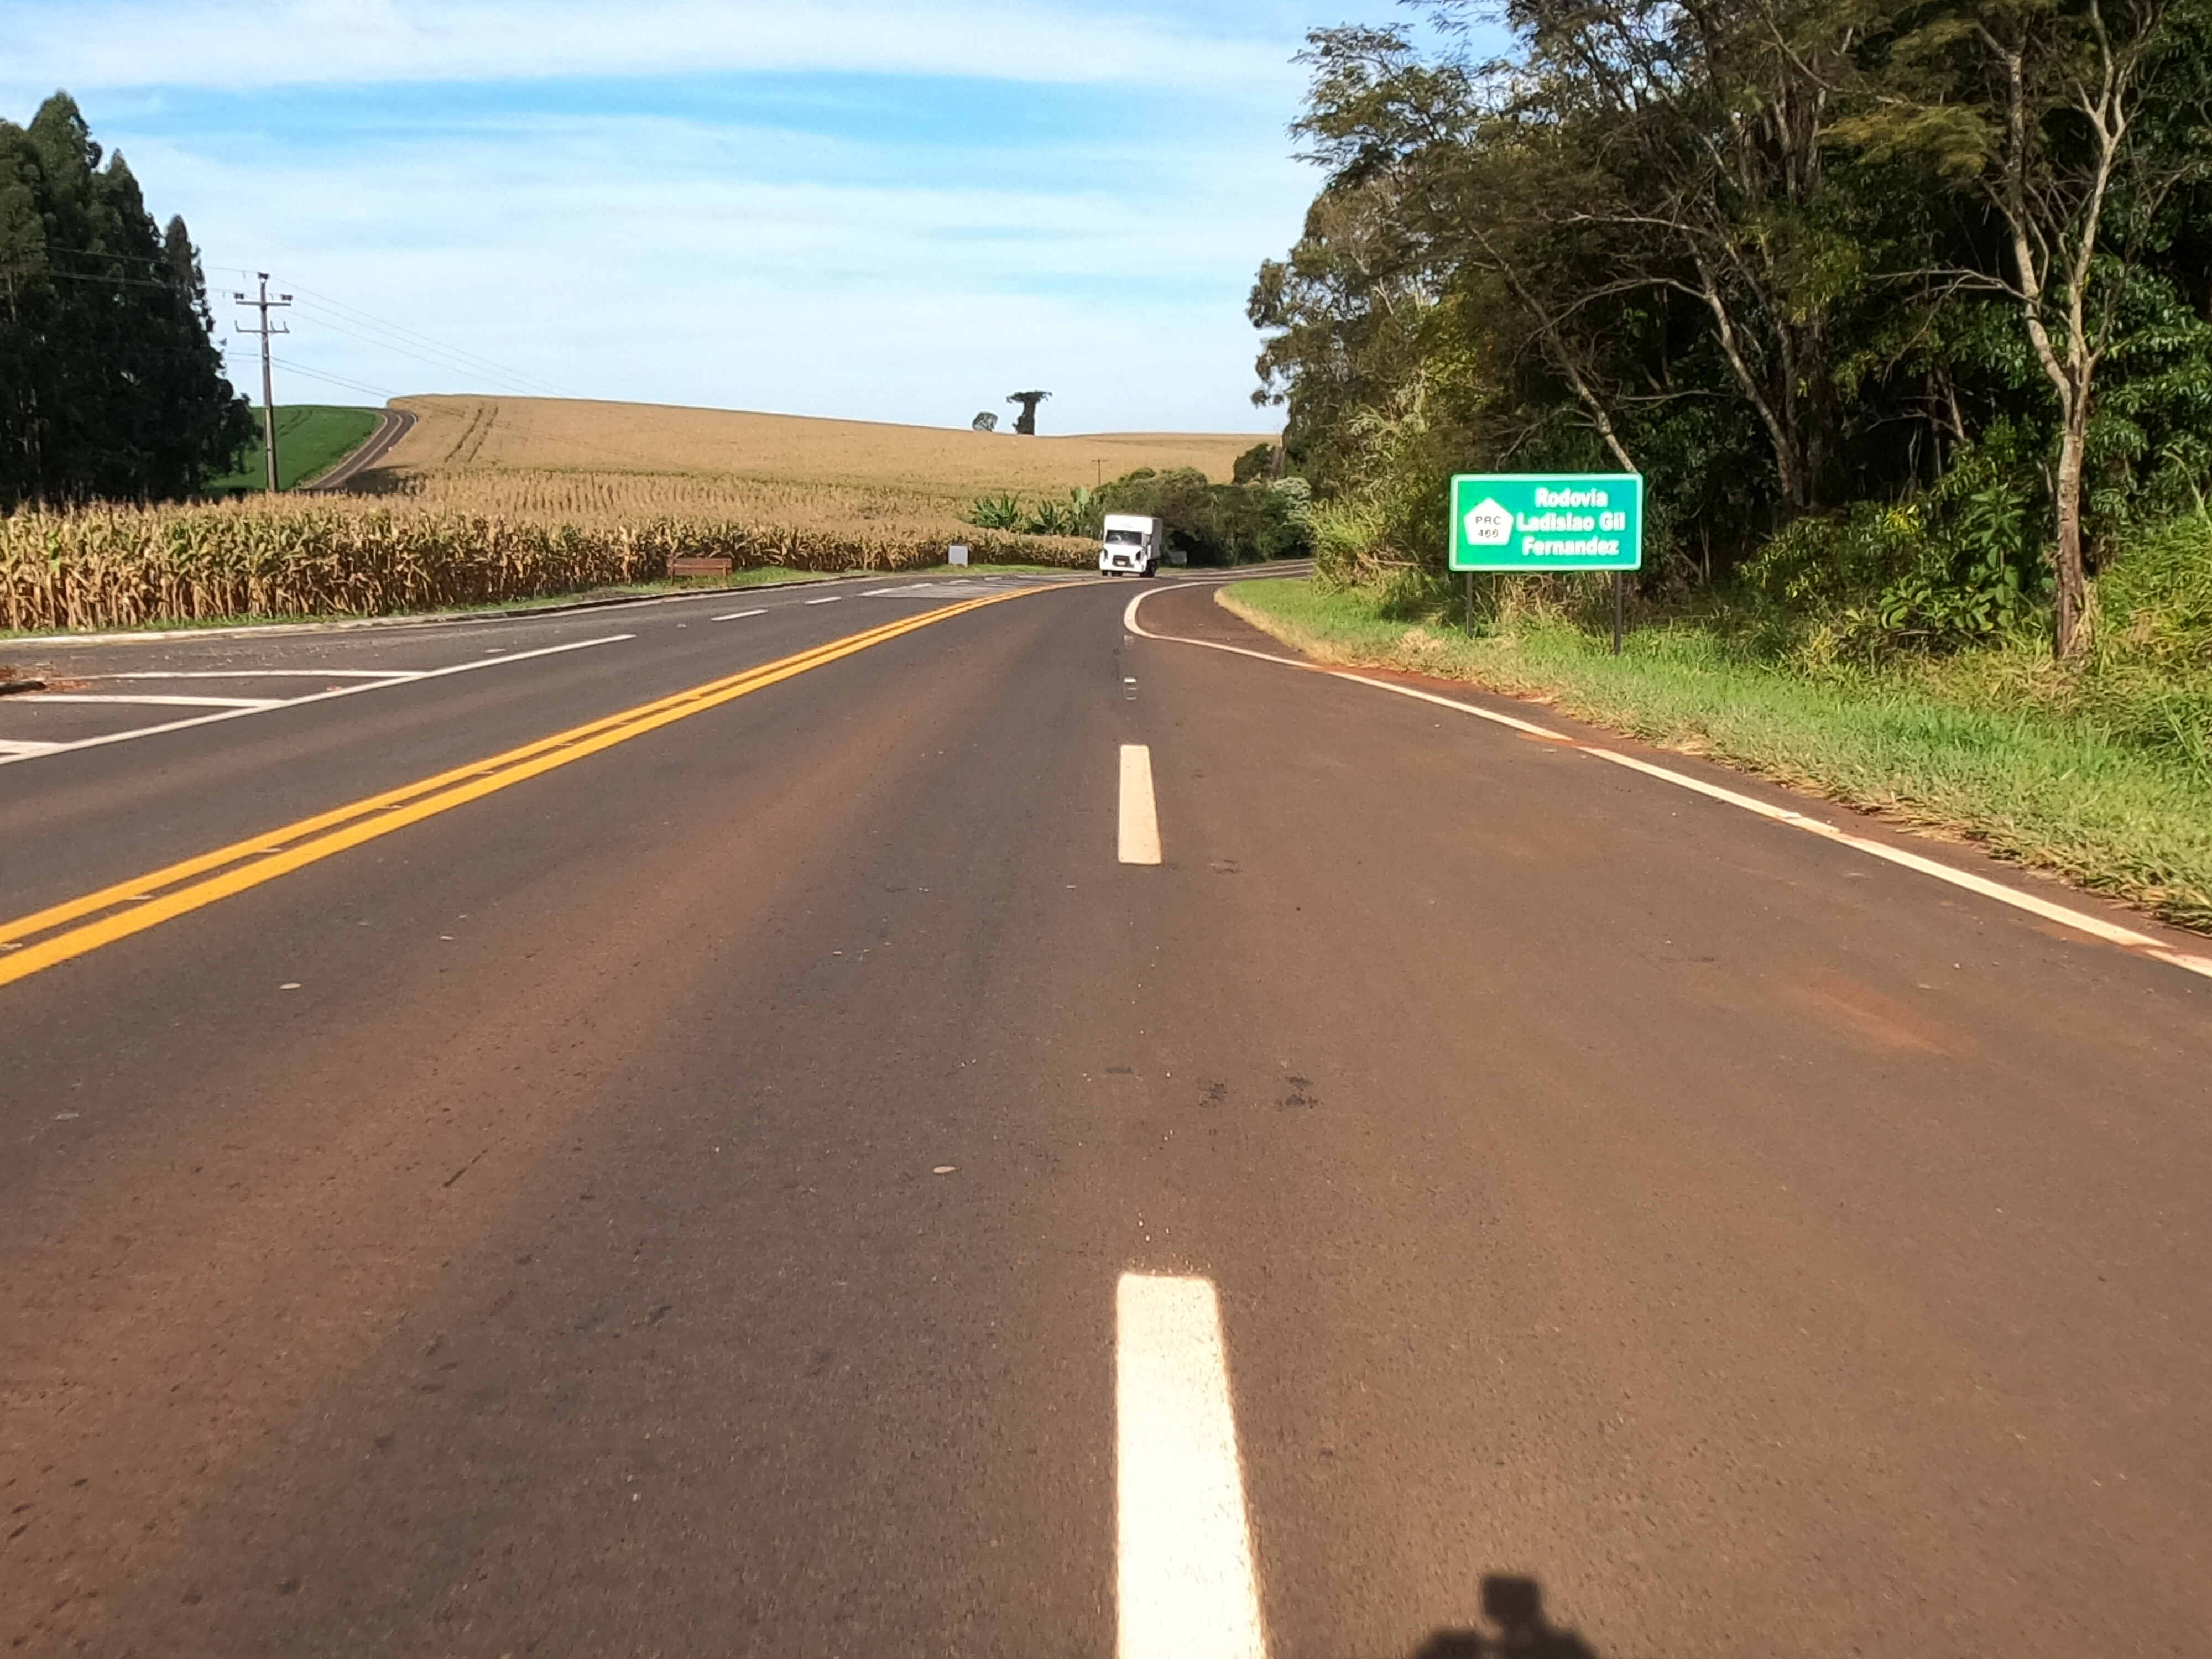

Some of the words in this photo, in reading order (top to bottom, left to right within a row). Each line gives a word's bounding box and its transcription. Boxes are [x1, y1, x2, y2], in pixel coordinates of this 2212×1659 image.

[1535, 487, 1608, 507] Rodovia
[1517, 512, 1595, 531] Ladislao
[1599, 511, 1626, 531] Gil
[1522, 535, 1620, 556] Fernandez
